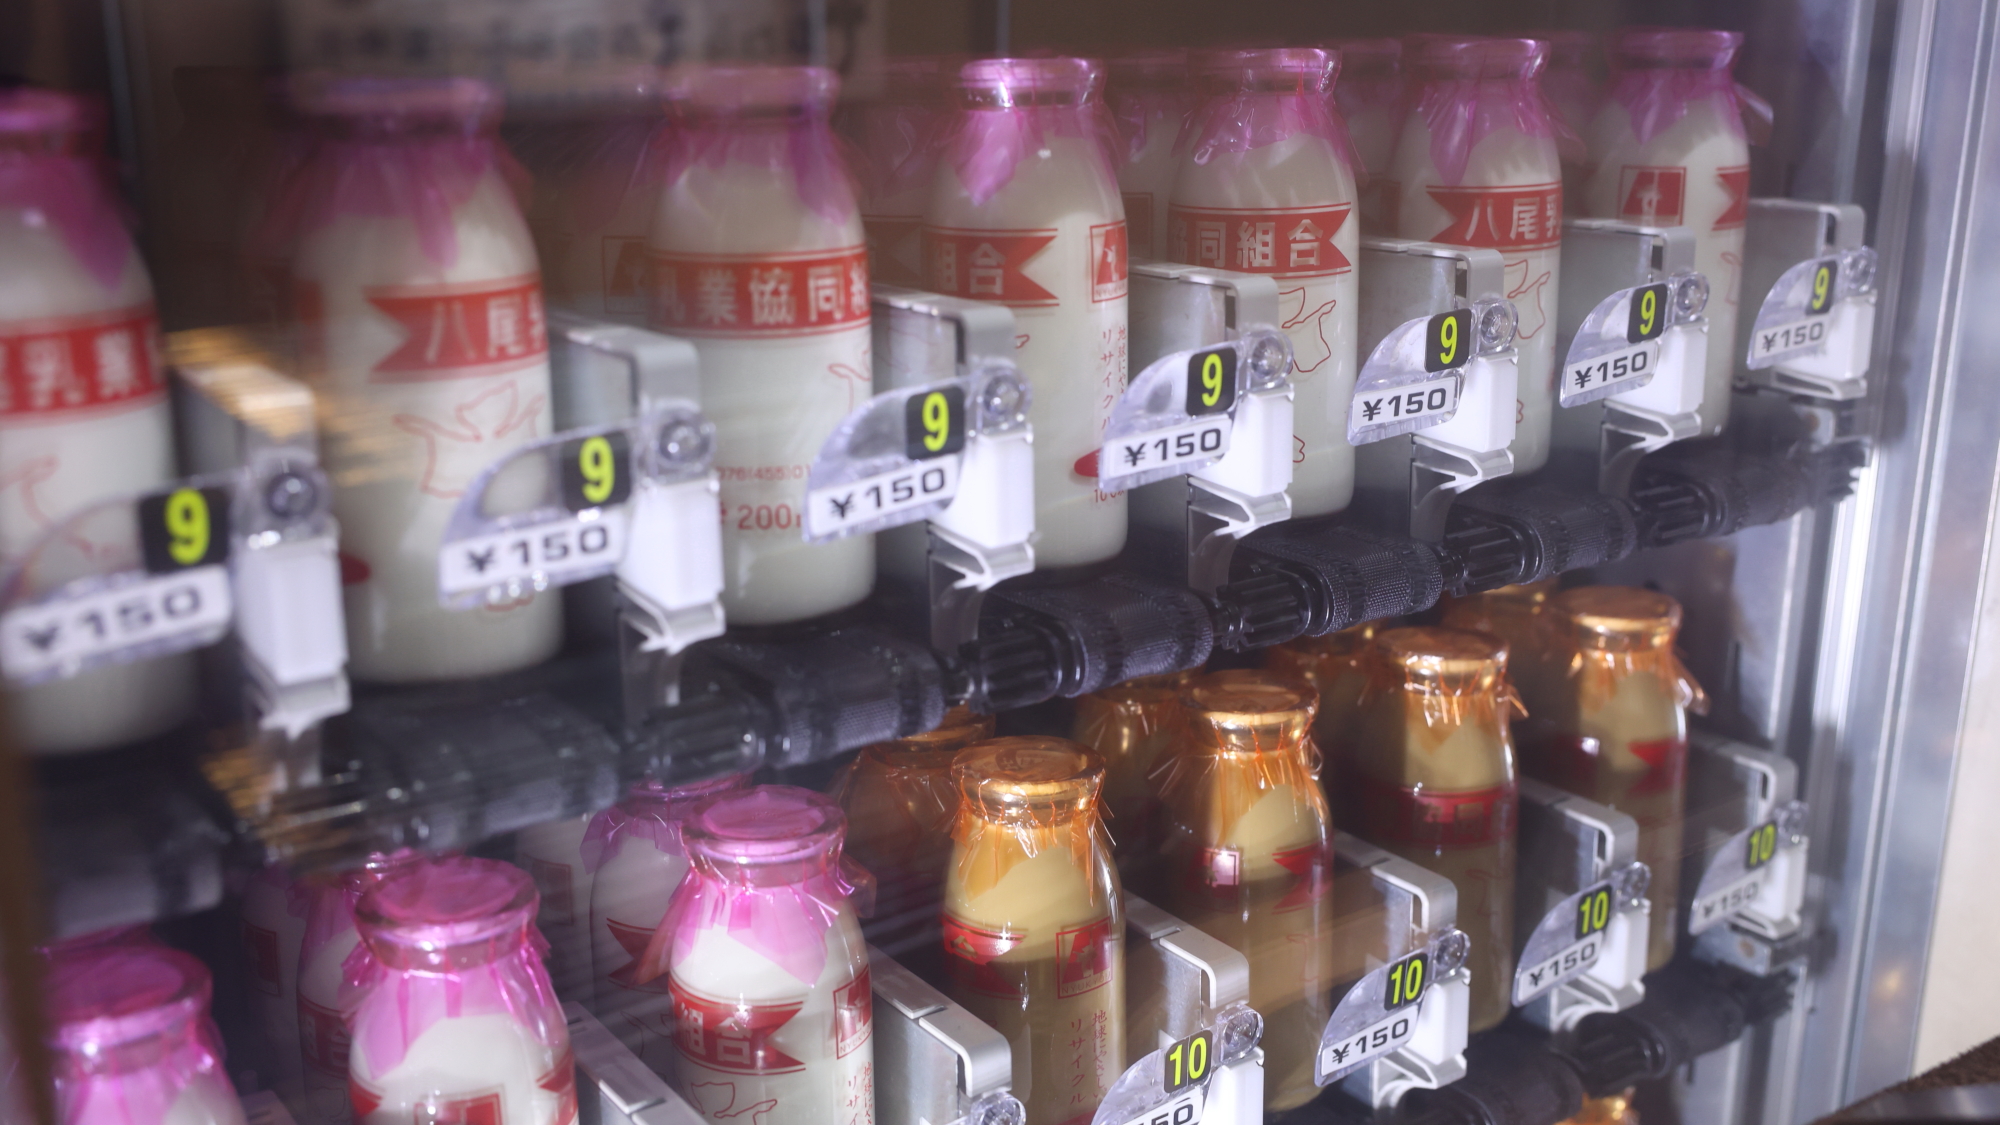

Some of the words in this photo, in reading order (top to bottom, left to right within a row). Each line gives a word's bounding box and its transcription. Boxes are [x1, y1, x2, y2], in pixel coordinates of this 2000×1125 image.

[1812, 267, 1829, 309] 9
[1640, 290, 1656, 335] 9
[1440, 316, 1458, 364] 9
[1762, 322, 1823, 353] ¥150
[1202, 353, 1223, 407] 9
[1574, 351, 1648, 388] ¥150
[922, 392, 949, 451] 9
[1363, 388, 1447, 421] ¥150
[579, 436, 614, 503] 9
[1124, 428, 1221, 467] ¥150
[830, 467, 946, 518] ¥150
[164, 487, 210, 565] 9
[737, 503, 802, 530] 200
[466, 526, 608, 572] ¥150
[23, 585, 203, 650] ¥150
[1748, 823, 1776, 866] 10
[1579, 890, 1609, 935] 10
[1703, 881, 1759, 918] ¥150
[1391, 958, 1423, 1005] 10
[1528, 942, 1596, 987] ¥150
[1067, 1018, 1086, 1105] リサイクル
[1169, 1036, 1208, 1087] 10
[1332, 1018, 1409, 1064] ¥150
